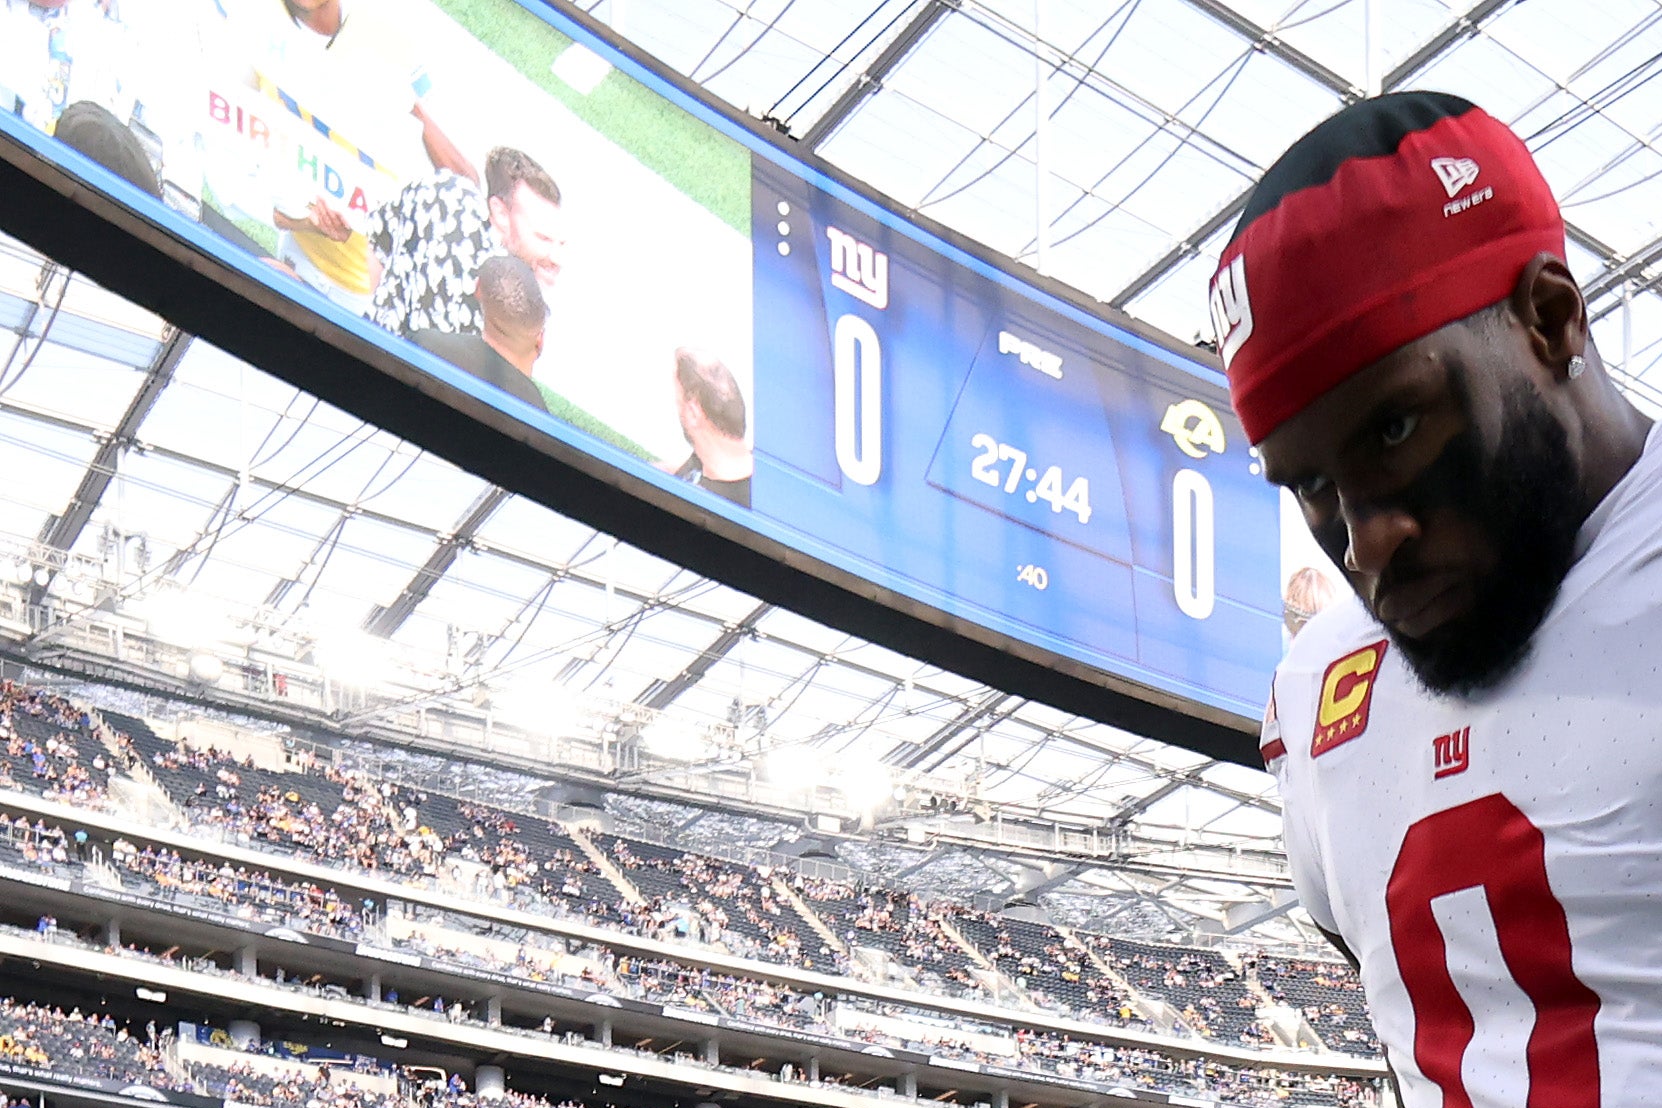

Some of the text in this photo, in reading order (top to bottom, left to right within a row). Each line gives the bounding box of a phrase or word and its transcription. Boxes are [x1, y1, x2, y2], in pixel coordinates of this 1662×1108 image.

[209, 89, 368, 213] BIRHDA
[834, 314, 881, 486] 0
[971, 433, 1092, 524] 27:44
[1016, 565, 1048, 590] :40
[1173, 468, 1214, 619] 0
[1319, 648, 1376, 727] C
[1433, 725, 1470, 780] ny
